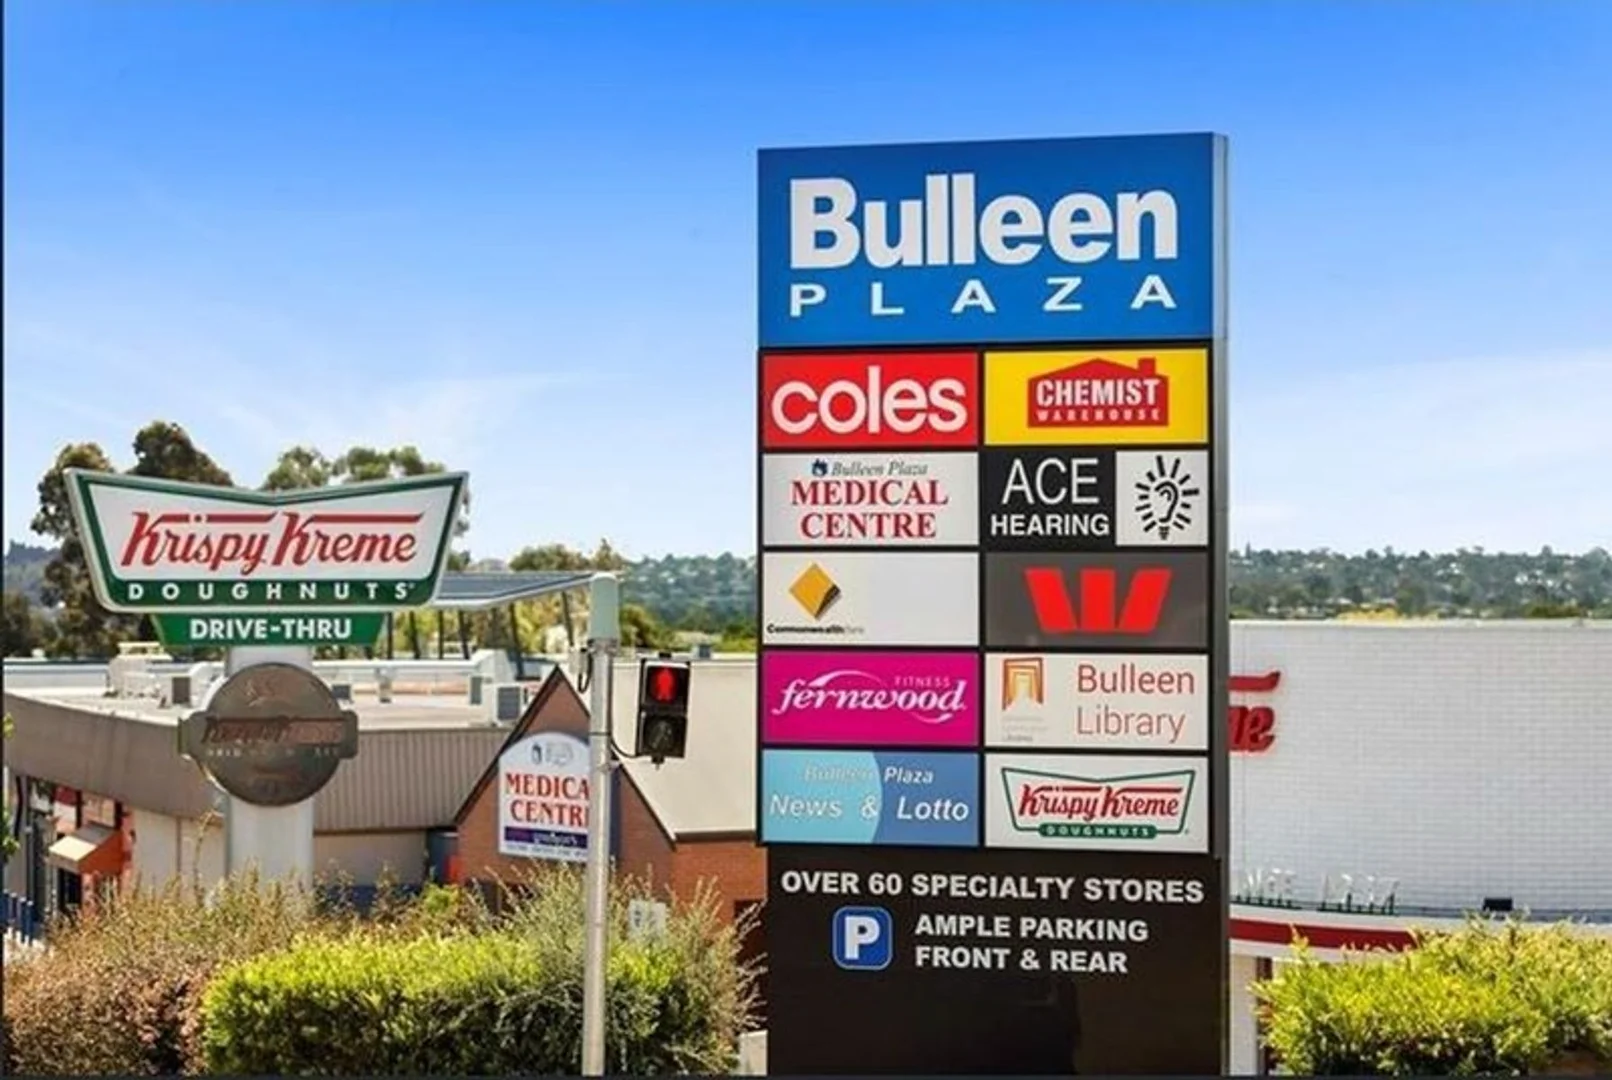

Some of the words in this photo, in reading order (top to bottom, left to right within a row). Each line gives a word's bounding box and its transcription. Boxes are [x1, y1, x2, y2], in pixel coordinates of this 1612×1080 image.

[790, 173, 1177, 270] Bulleen
[790, 274, 1176, 317] PLAZA
[771, 366, 967, 434] coles
[1036, 378, 1160, 407] CHEMIST
[1037, 408, 1159, 422] WAREHOUSE
[831, 461, 885, 476] Bulleen
[888, 461, 928, 475] Plaza
[1002, 457, 1099, 504] ACE
[791, 480, 949, 506] MEDICAL
[801, 512, 936, 538] CENTRE
[991, 514, 1110, 537] HEARING
[120, 511, 278, 575] Krispy
[271, 511, 425, 566] Kreme
[128, 582, 408, 599] DOUGHNUTS
[190, 617, 351, 640] DRIVE-THRU
[894, 676, 951, 689] FITNESS
[1078, 663, 1195, 695] Bulleen
[772, 678, 968, 715] fernwood
[1077, 703, 1186, 741] Library
[505, 772, 589, 800] MEDICA
[884, 765, 935, 785] Plaza
[769, 793, 843, 818] News
[861, 795, 880, 819] &
[897, 795, 970, 822] Lotto
[1018, 783, 1103, 822] Krispy
[1100, 785, 1183, 818] Kreme
[1046, 825, 1151, 837] DOUGHNUTS
[781, 870, 860, 895] OVER
[868, 872, 903, 896] 60
[912, 874, 1075, 901] SPECIALTY
[1083, 879, 1205, 903] STORES
[843, 915, 881, 961] P
[915, 913, 1012, 939] AMPLE
[1020, 916, 1149, 942] PARKING
[915, 946, 1010, 969] FRONT
[1020, 948, 1040, 971] &
[1050, 949, 1129, 973] REAR
